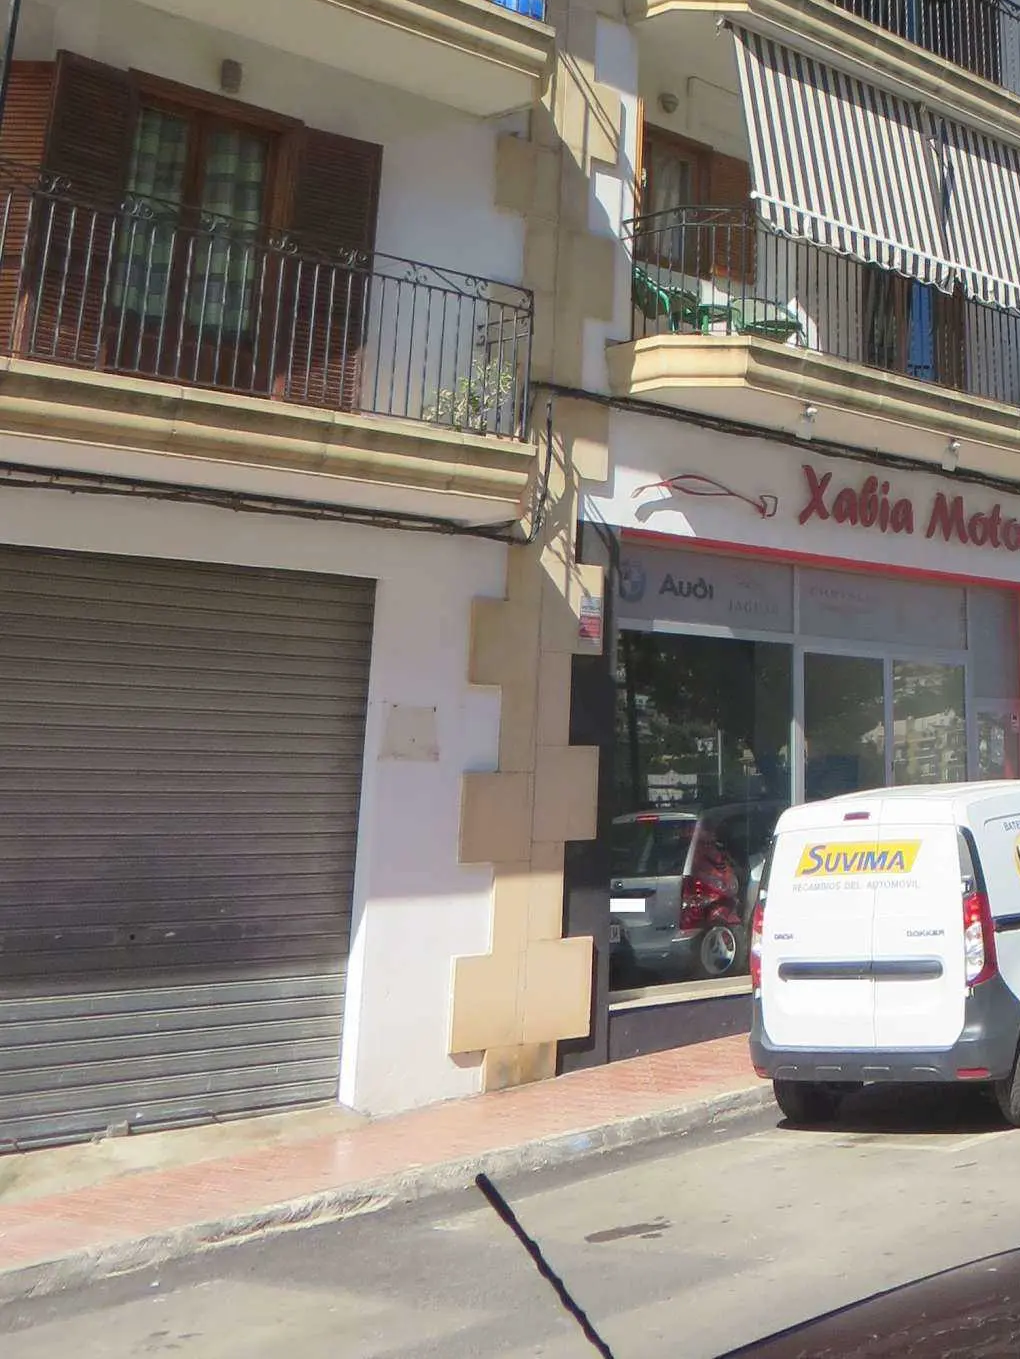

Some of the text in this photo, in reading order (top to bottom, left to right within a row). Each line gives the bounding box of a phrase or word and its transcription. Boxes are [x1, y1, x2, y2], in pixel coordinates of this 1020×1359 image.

[799, 464, 914, 534] Xabia
[658, 573, 714, 600] Audi
[802, 844, 905, 875] SUVIMA
[844, 880, 861, 890] DEL
